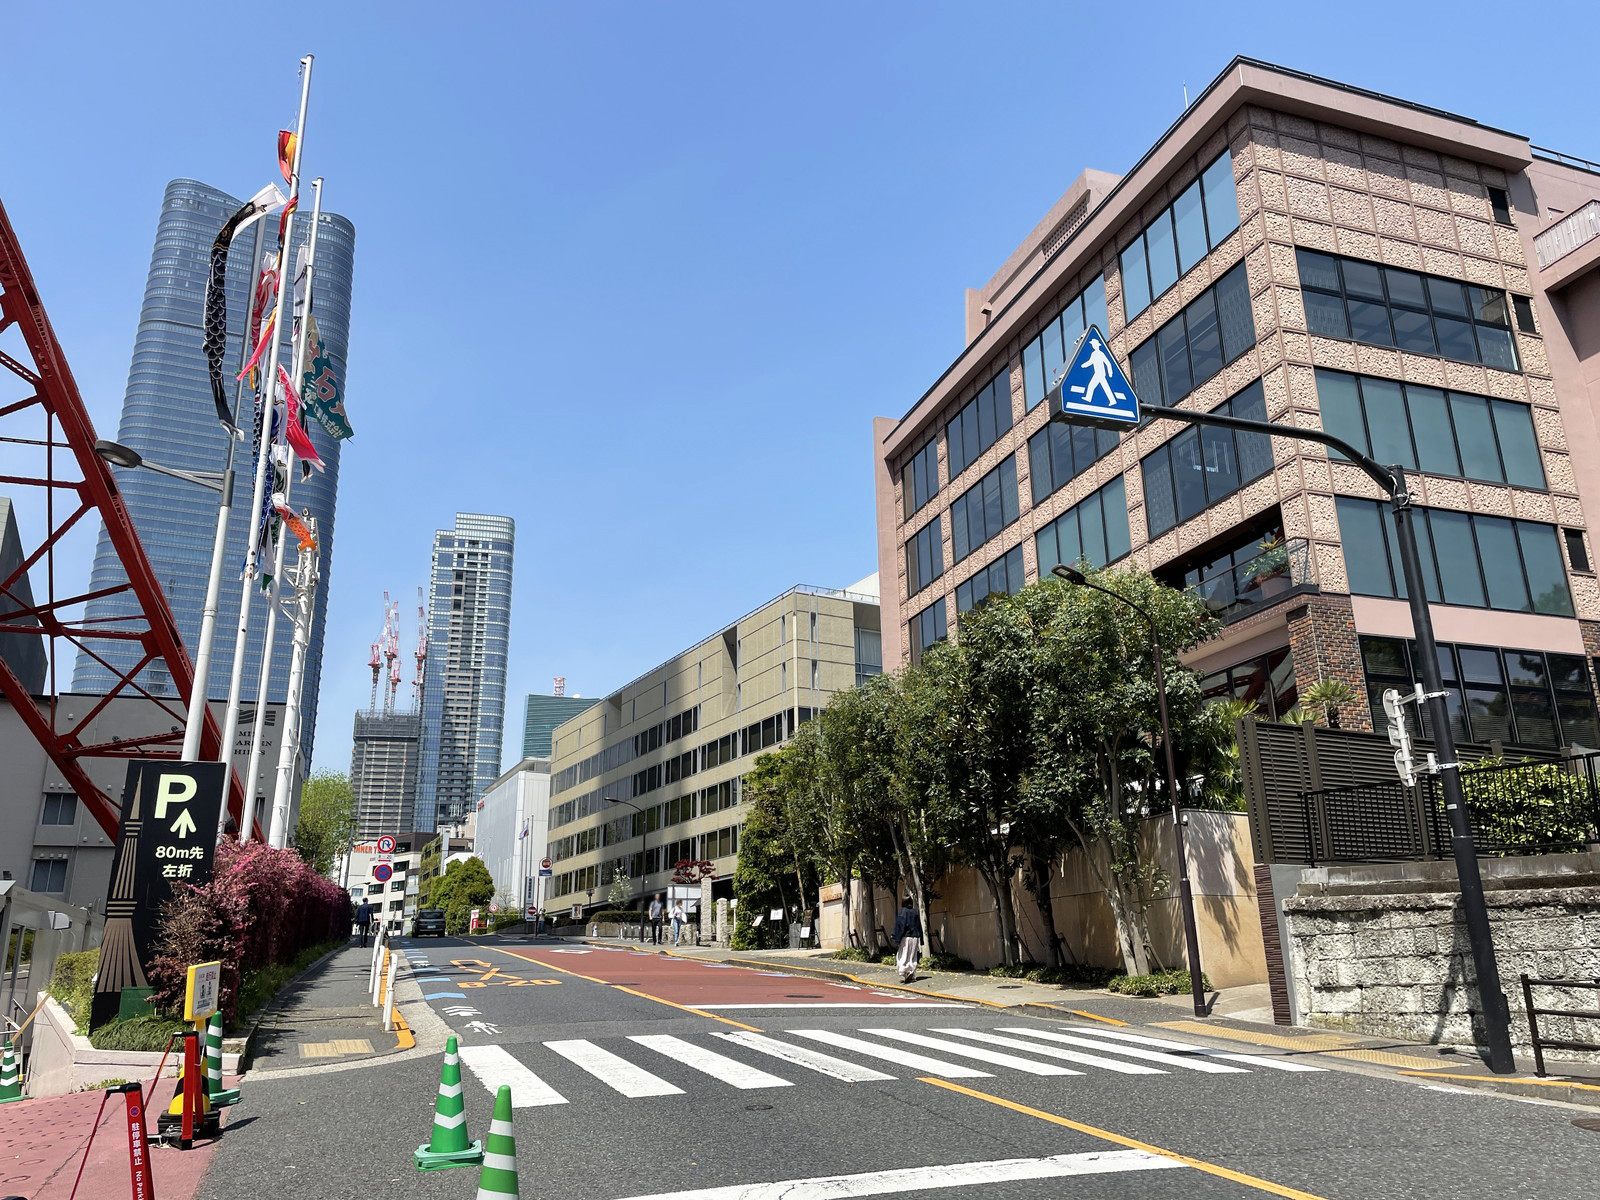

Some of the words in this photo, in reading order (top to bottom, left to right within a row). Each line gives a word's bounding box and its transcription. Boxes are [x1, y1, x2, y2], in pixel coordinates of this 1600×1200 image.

[154, 774, 198, 819] P
[155, 845, 204, 860] 80m先
[162, 863, 193, 878] 左折
